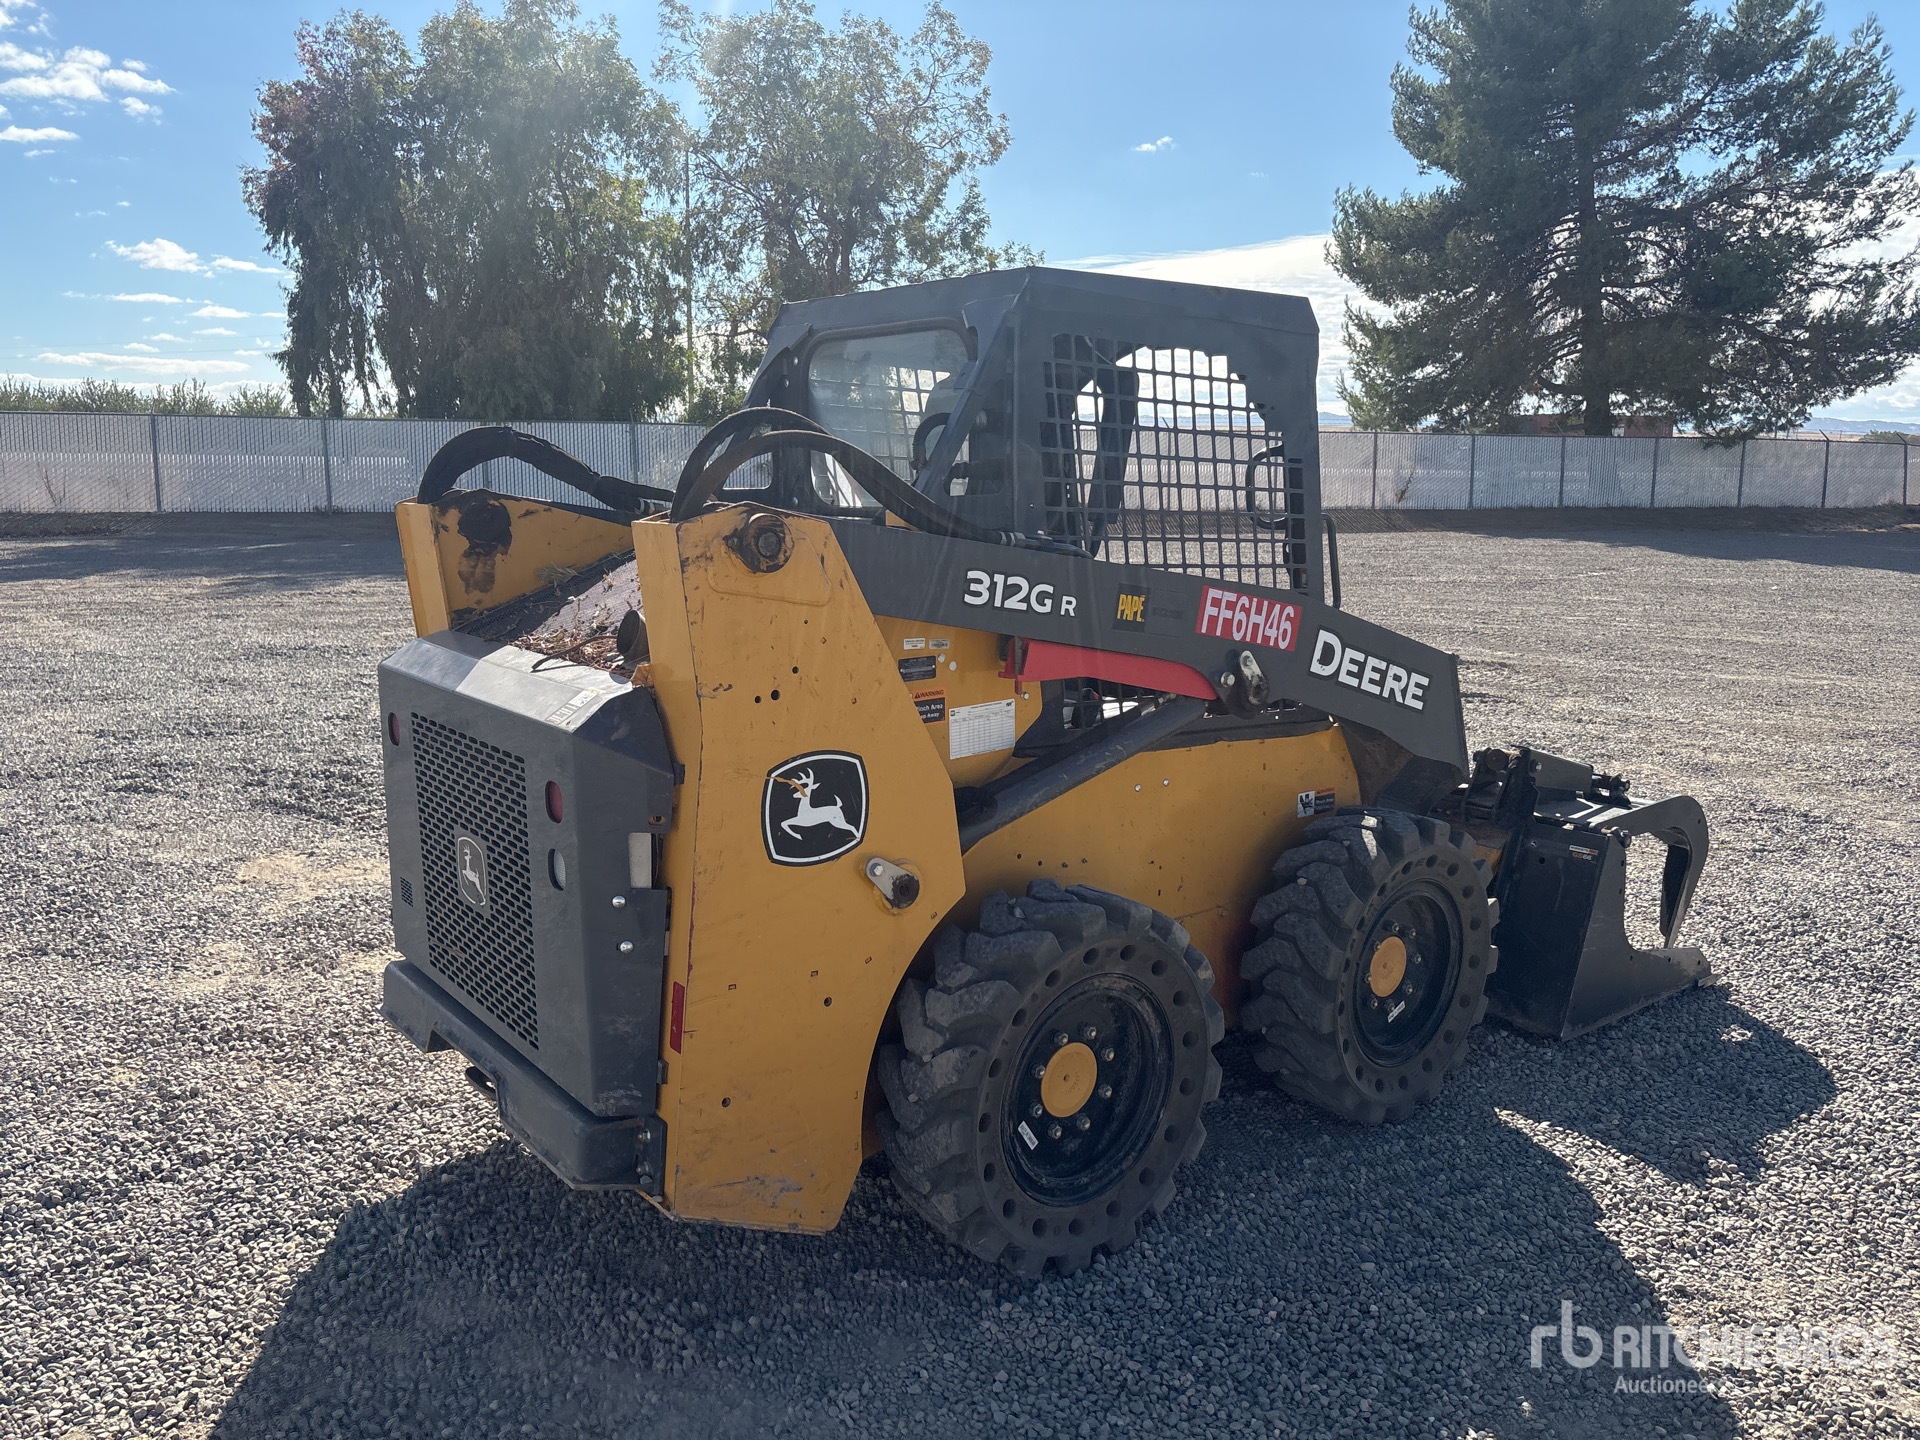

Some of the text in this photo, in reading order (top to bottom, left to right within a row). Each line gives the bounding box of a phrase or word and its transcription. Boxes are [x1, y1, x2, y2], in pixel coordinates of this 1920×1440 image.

[963, 570, 1077, 616] 312G R
[1201, 588, 1294, 650] FF6H46
[920, 690, 944, 698] WARNING
[1310, 629, 1430, 710] DEERE
